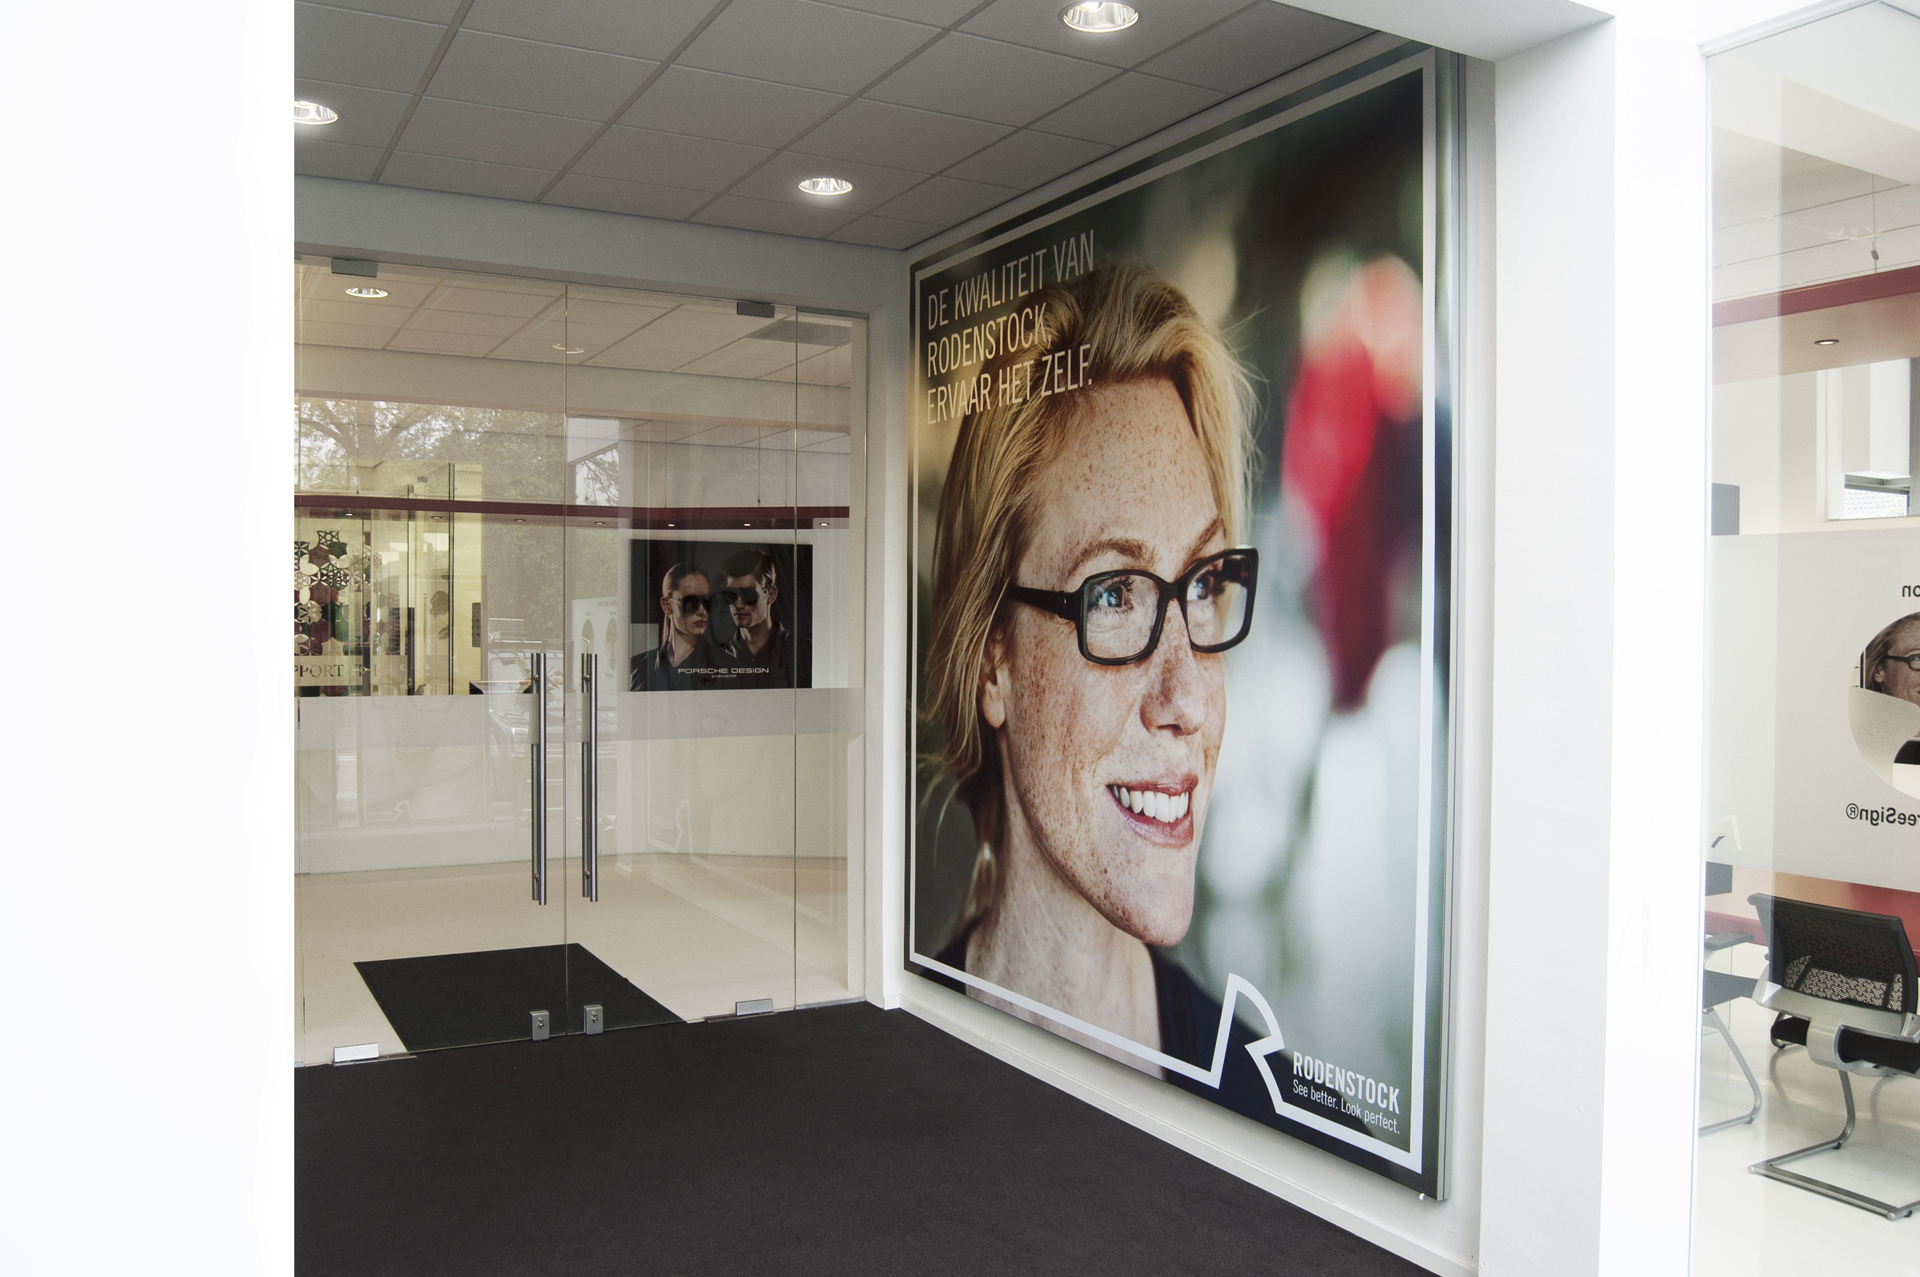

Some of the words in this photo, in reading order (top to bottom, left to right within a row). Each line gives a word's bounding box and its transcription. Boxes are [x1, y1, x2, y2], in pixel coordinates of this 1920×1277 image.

[928, 288, 949, 330] DE
[954, 248, 1047, 320] KWALITEIT
[1053, 229, 1094, 283] VAN
[927, 373, 991, 425] ERVAAR
[999, 360, 1035, 407] HET
[1040, 343, 1093, 397] ZELF.
[1293, 1051, 1400, 1115] RODENSTOCK
[1293, 1079, 1309, 1098] See
[1311, 1086, 1338, 1110] better.
[1341, 1102, 1362, 1119] Look
[1364, 1110, 1400, 1135] perfect.
